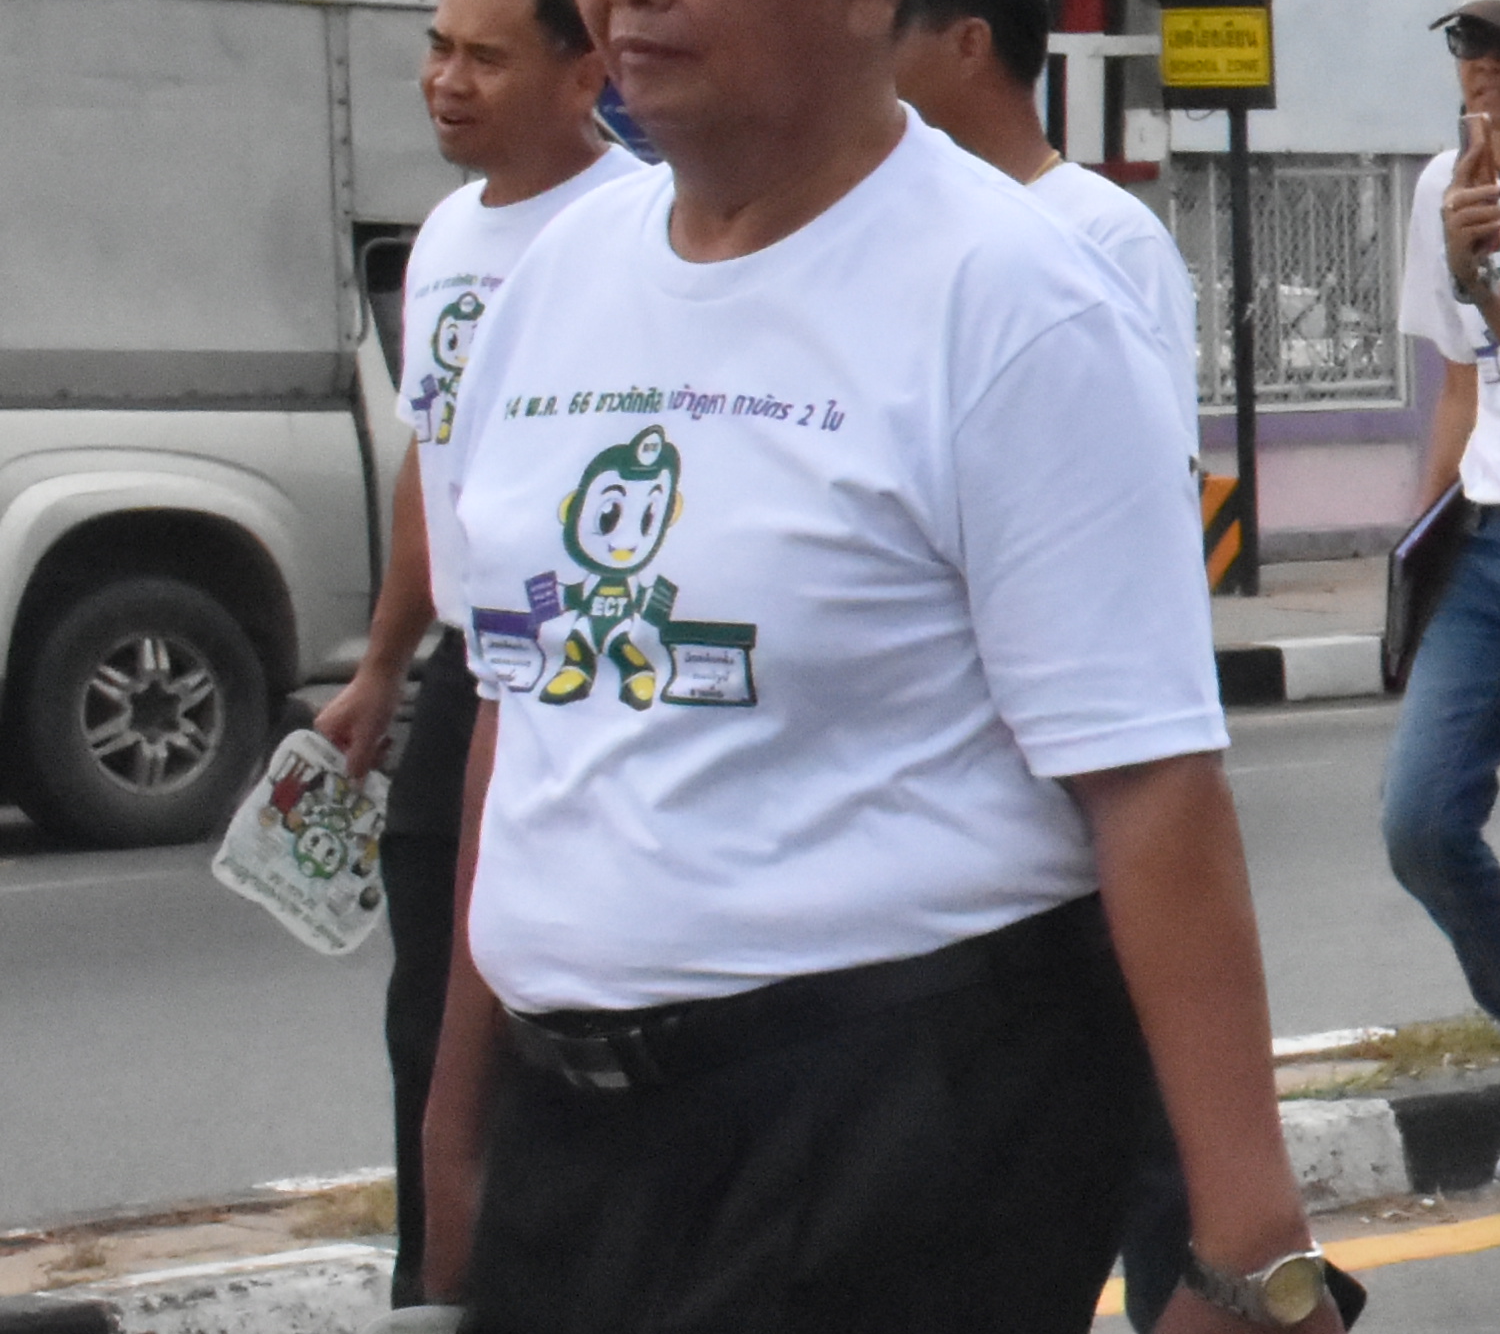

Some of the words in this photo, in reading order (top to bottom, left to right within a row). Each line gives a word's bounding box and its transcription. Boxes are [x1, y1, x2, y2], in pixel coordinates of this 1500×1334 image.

[568, 391, 594, 415] 66
[732, 393, 793, 421] กาบัตร
[797, 404, 814, 427] 2
[821, 399, 845, 432] ใบ
[591, 596, 628, 618] ECT
